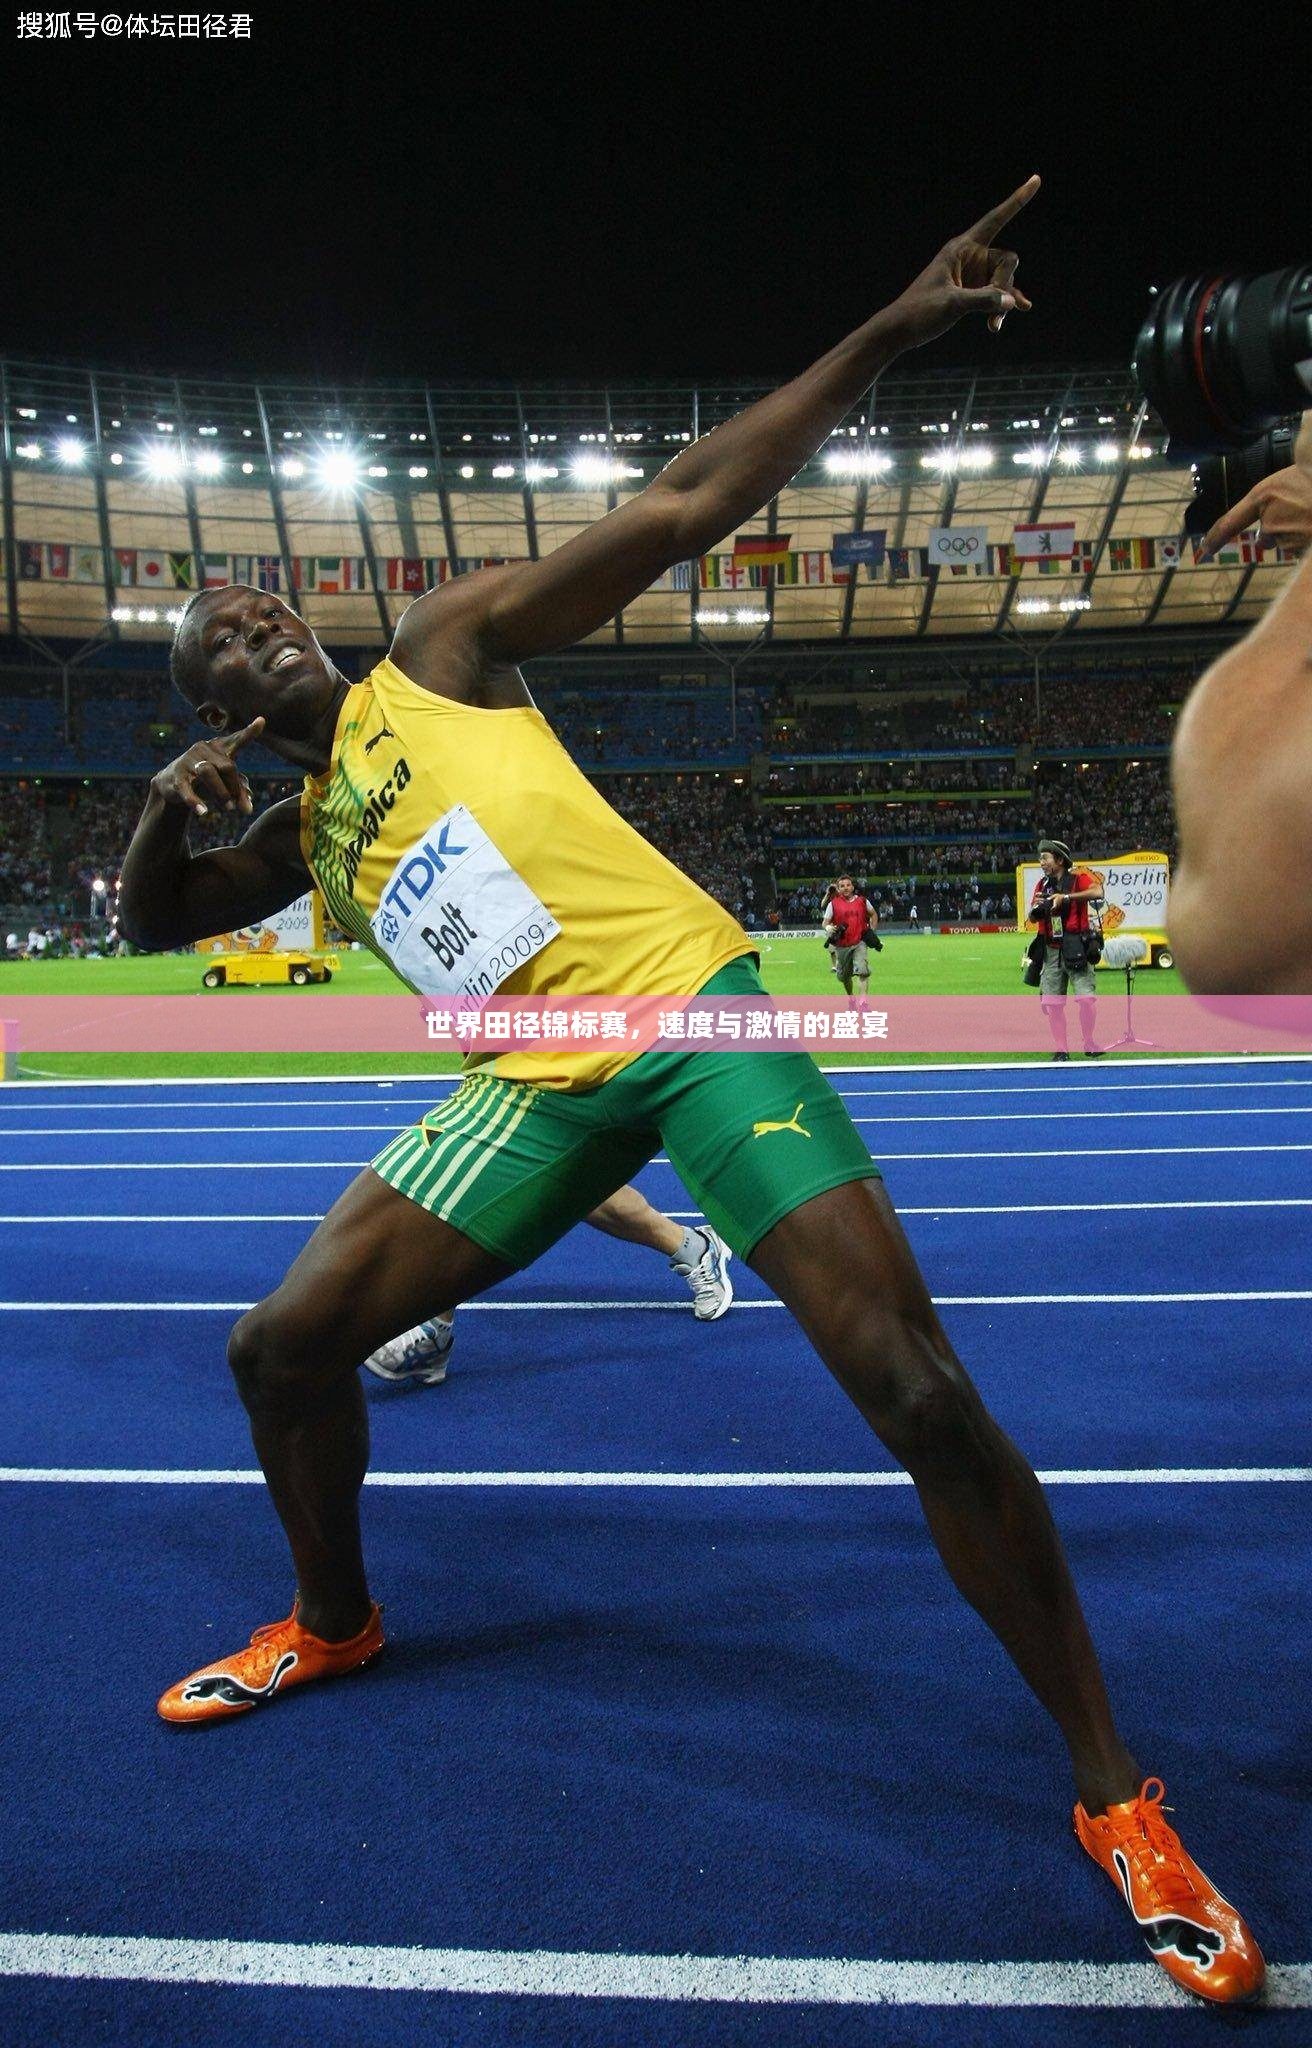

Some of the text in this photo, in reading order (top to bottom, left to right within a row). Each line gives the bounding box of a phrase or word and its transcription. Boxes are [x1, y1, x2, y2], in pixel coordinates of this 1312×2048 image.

[384, 819, 469, 918] TDK
[1106, 868, 1167, 886] berlin
[1123, 890, 1163, 906] 2009
[276, 917, 309, 930] 2009
[420, 902, 478, 972] Bolt
[489, 924, 545, 980] 2009
